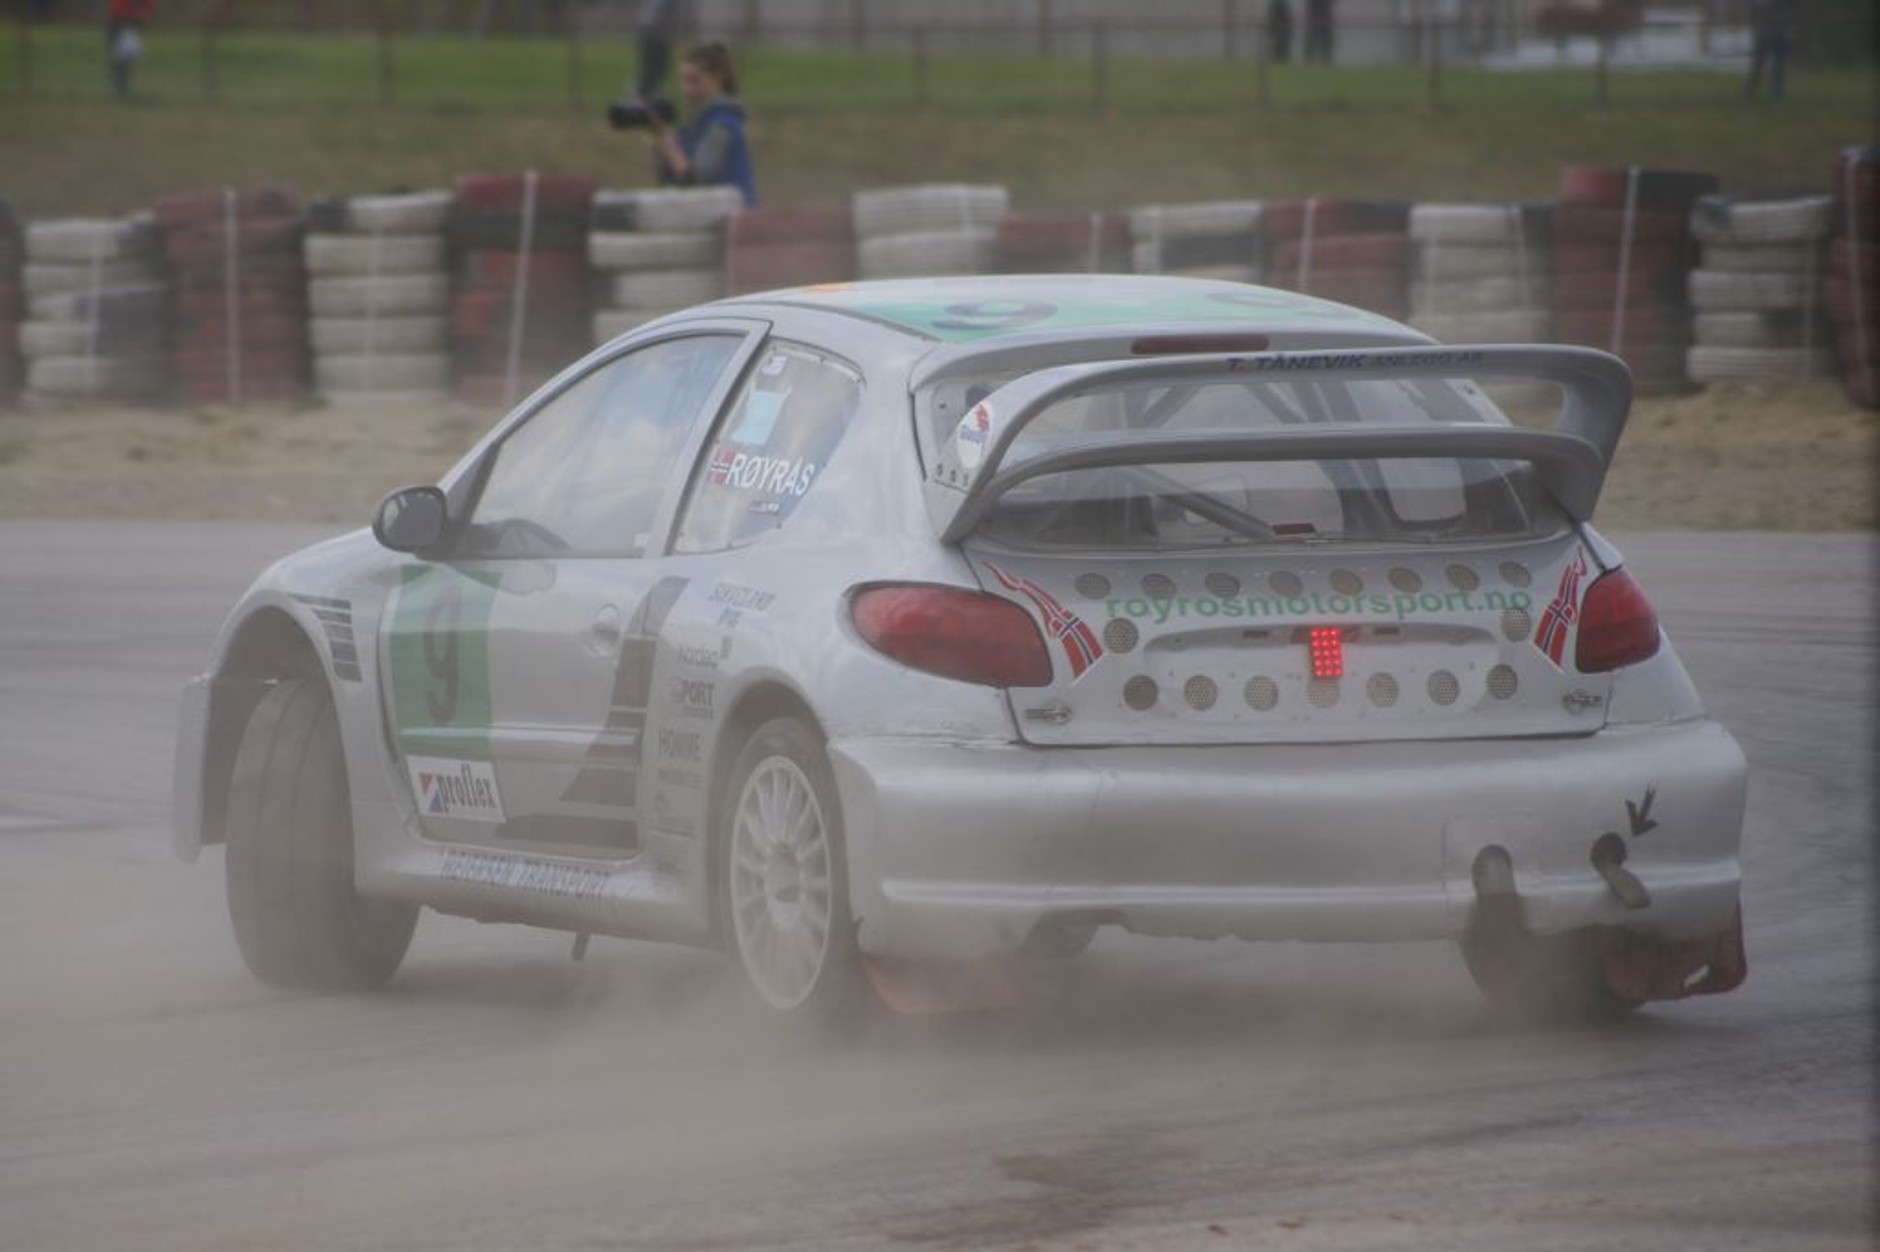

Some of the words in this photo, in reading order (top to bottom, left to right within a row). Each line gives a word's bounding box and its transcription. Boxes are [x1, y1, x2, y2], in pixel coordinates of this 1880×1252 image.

[1227, 357, 1245, 371] T.
[1105, 588, 1532, 623] royrosmotorsport.no
[422, 586, 461, 725] 9
[438, 762, 498, 814] proflex
